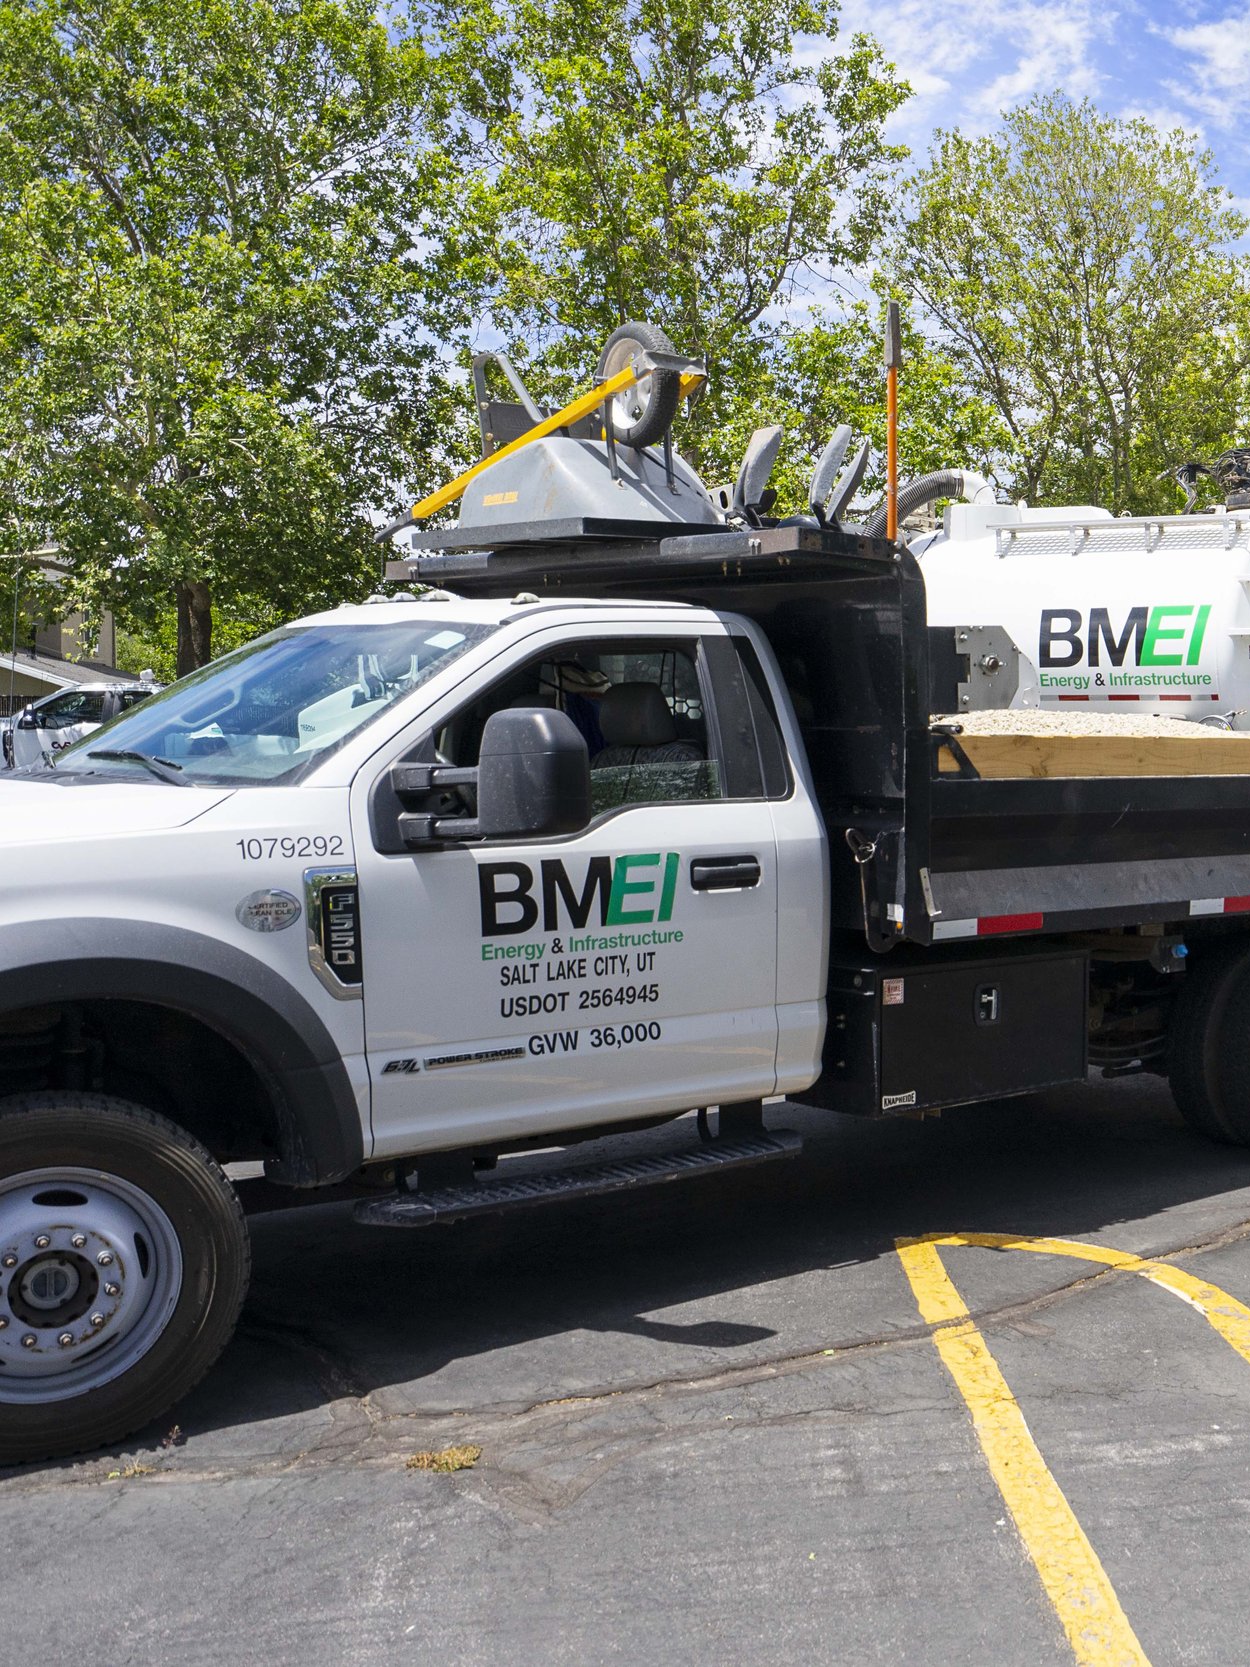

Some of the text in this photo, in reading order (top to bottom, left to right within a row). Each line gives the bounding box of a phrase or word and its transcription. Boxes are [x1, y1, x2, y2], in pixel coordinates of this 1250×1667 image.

[1039, 604, 1212, 668] BMEI
[1040, 672, 1212, 689] Energy & Infrastructure
[236, 835, 344, 860] 1079292
[478, 852, 680, 937] BMEI
[329, 893, 355, 965] F550
[481, 928, 684, 961] Energy & Infrastructure
[500, 952, 656, 986] SALT LAKE CITY, UT
[500, 984, 659, 1018] USDOT 2564945
[528, 1021, 661, 1055] GVW 36,000
[428, 1052, 472, 1066] POWER
[475, 1047, 523, 1060] STROKE
[884, 1092, 915, 1107] KNAPHEIDE
